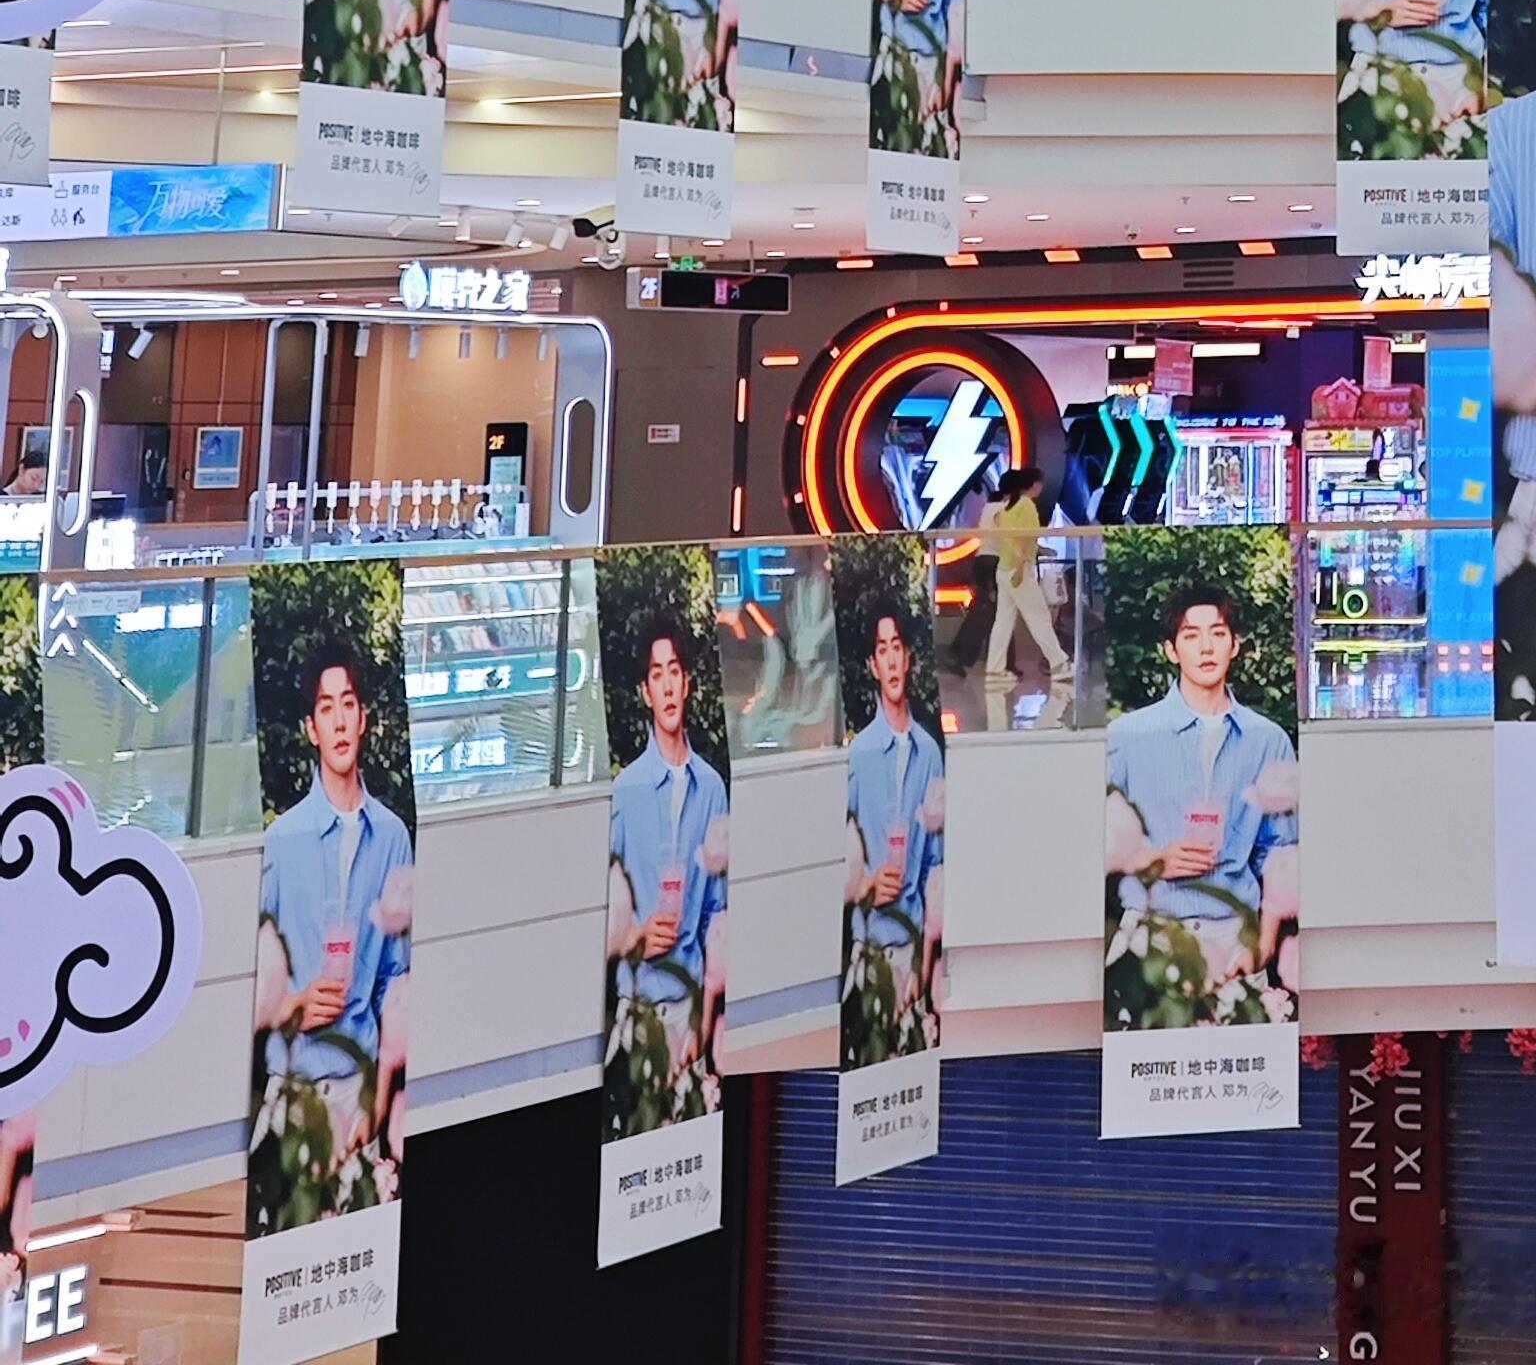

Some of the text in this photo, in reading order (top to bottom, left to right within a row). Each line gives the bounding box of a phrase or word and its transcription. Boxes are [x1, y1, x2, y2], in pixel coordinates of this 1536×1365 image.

[1131, 1057, 1265, 1078] POSITIVE 地中海咖啡
[1350, 1064, 1377, 1223] YAN YU
[1394, 1145, 1421, 1190] XI
